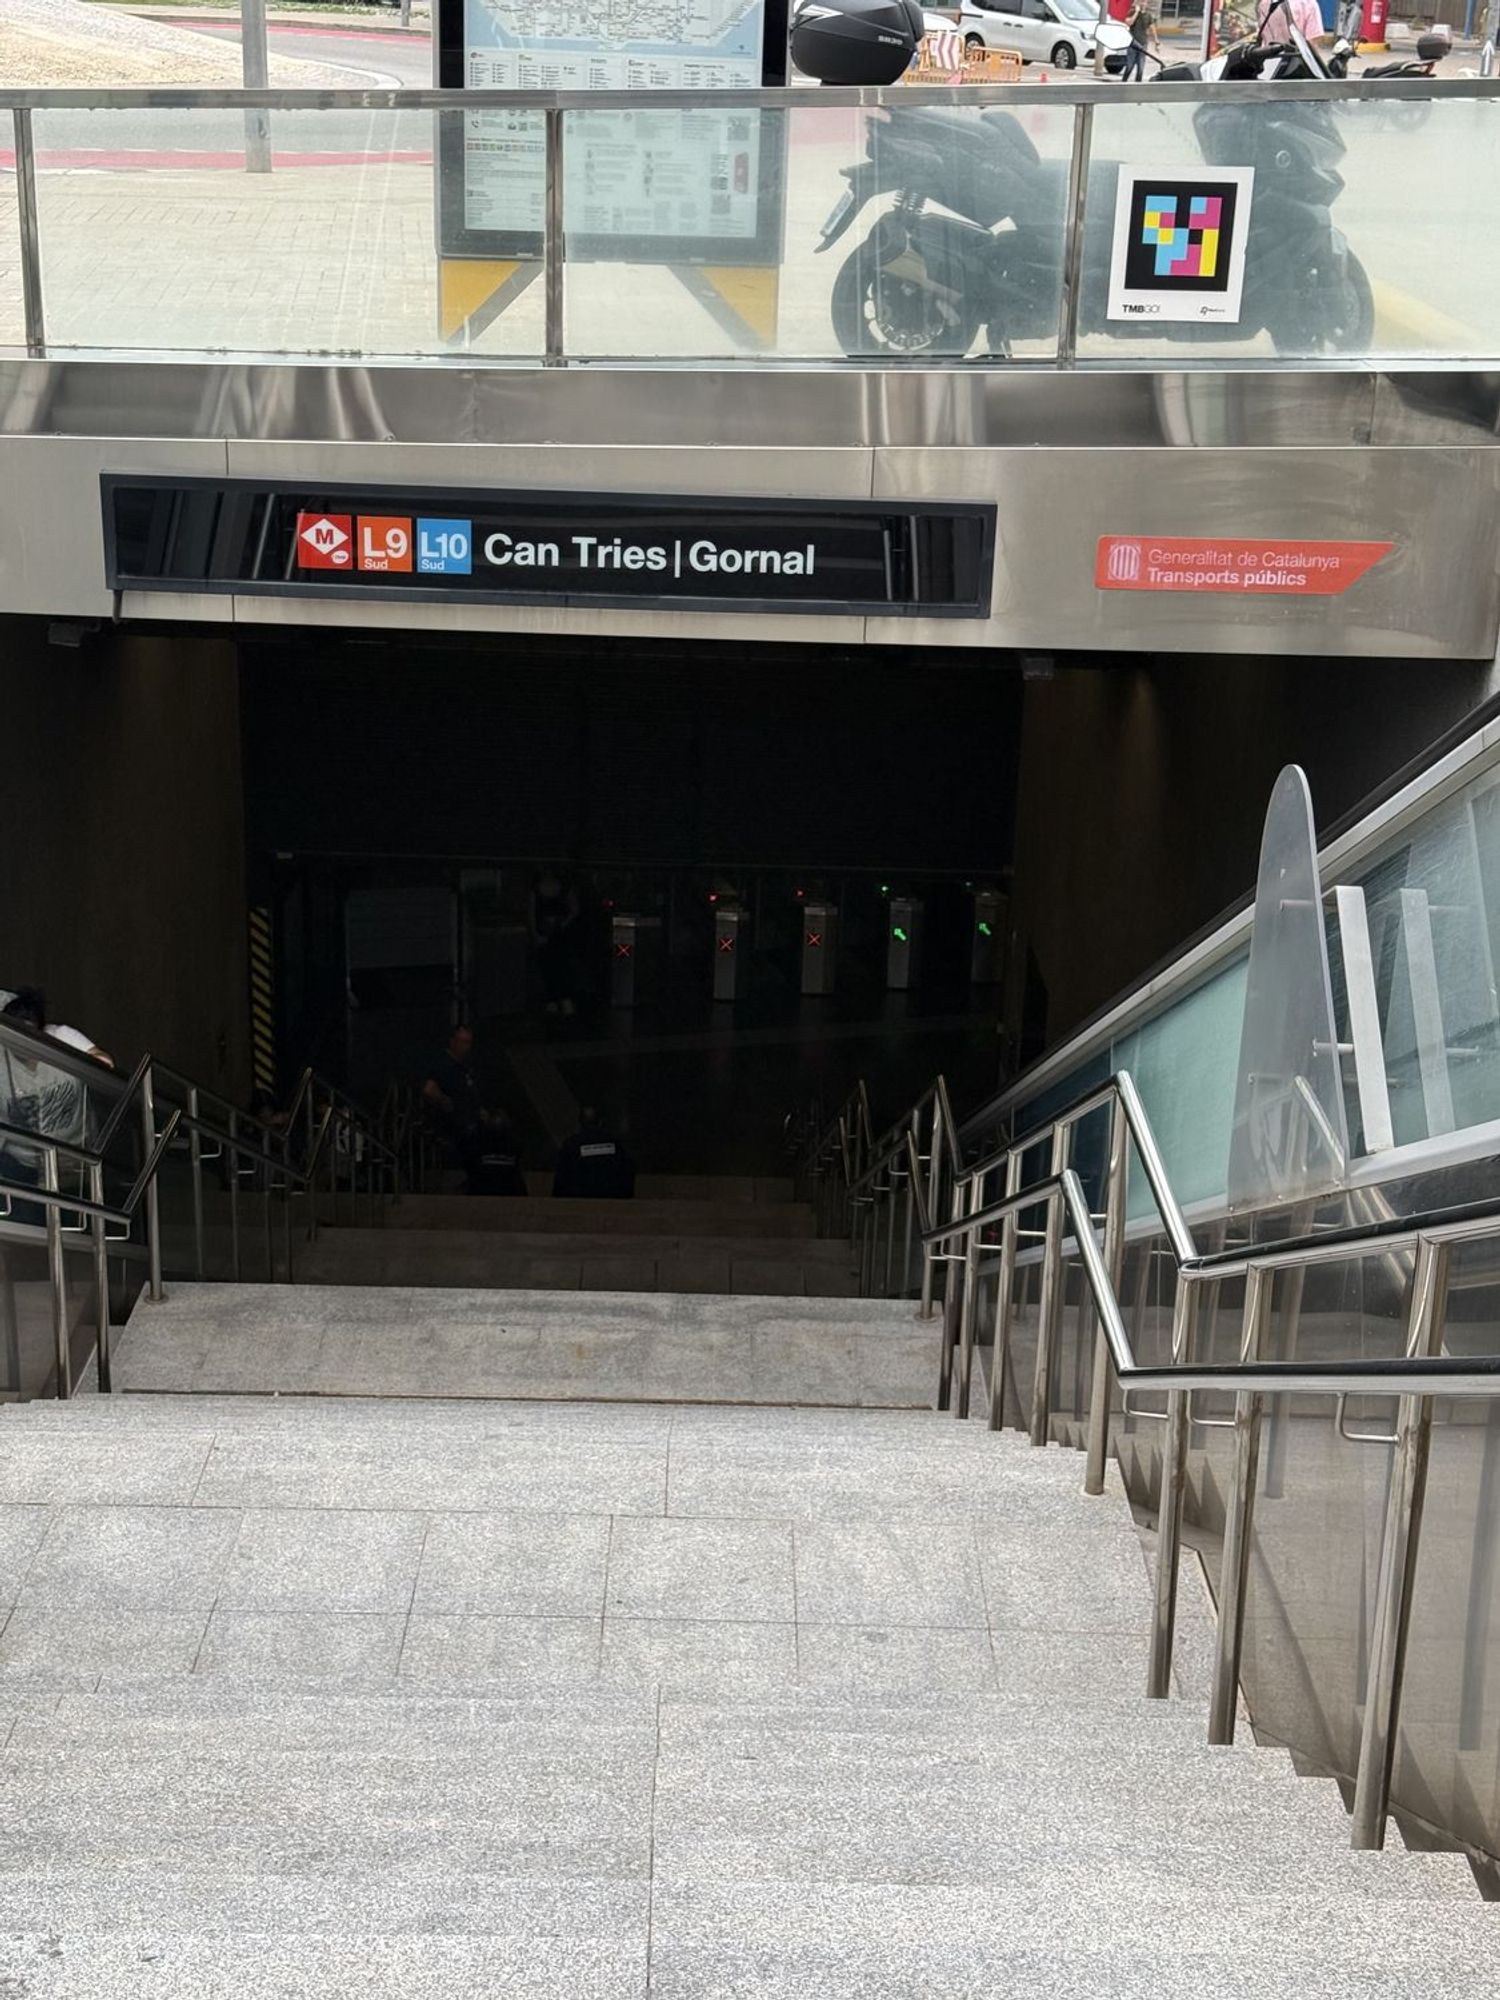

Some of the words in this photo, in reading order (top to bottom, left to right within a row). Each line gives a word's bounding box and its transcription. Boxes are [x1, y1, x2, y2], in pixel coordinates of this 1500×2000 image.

[315, 528, 334, 545] M
[363, 527, 408, 559] L9
[421, 532, 468, 560] L10
[484, 533, 559, 567] Can
[1148, 548, 1233, 566] Generalitat
[1238, 551, 1258, 567] de
[1262, 552, 1340, 572] Catalunya
[364, 558, 389, 570] Sud
[421, 558, 445, 571] Sud
[1148, 567, 1240, 585] Transports
[1243, 568, 1307, 588] públics
